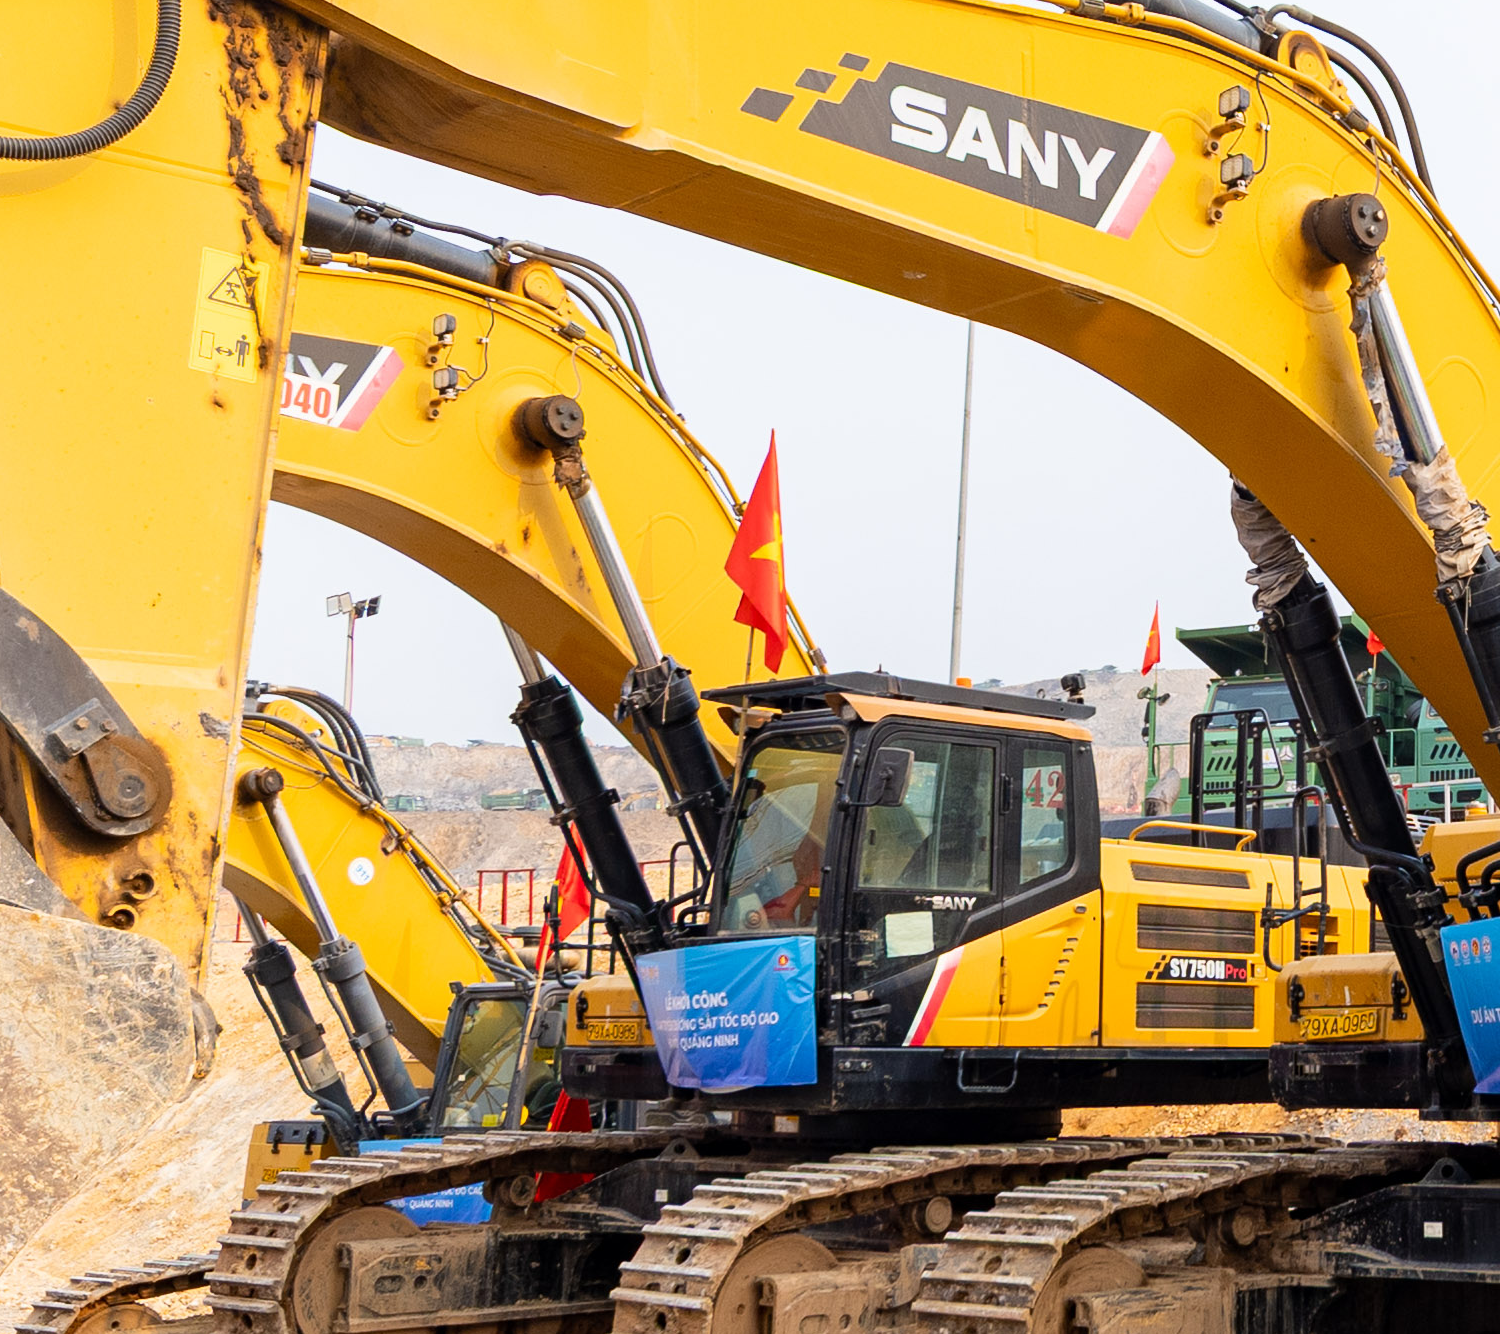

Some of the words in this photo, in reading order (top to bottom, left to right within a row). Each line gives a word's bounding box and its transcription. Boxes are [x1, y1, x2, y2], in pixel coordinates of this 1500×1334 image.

[890, 85, 1117, 200] SANY
[1025, 769, 1066, 809] 42
[931, 895, 977, 911] SANY
[691, 989, 729, 1009] CÔNG
[697, 1014, 718, 1030] SẮT
[720, 1011, 739, 1028] TỐC
[741, 1011, 757, 1029] ĐỘ
[758, 1012, 779, 1026] CAO
[680, 1034, 712, 1051] QUẢNG
[714, 1034, 739, 1048] NINH
[435, 1198, 454, 1209] NINH
